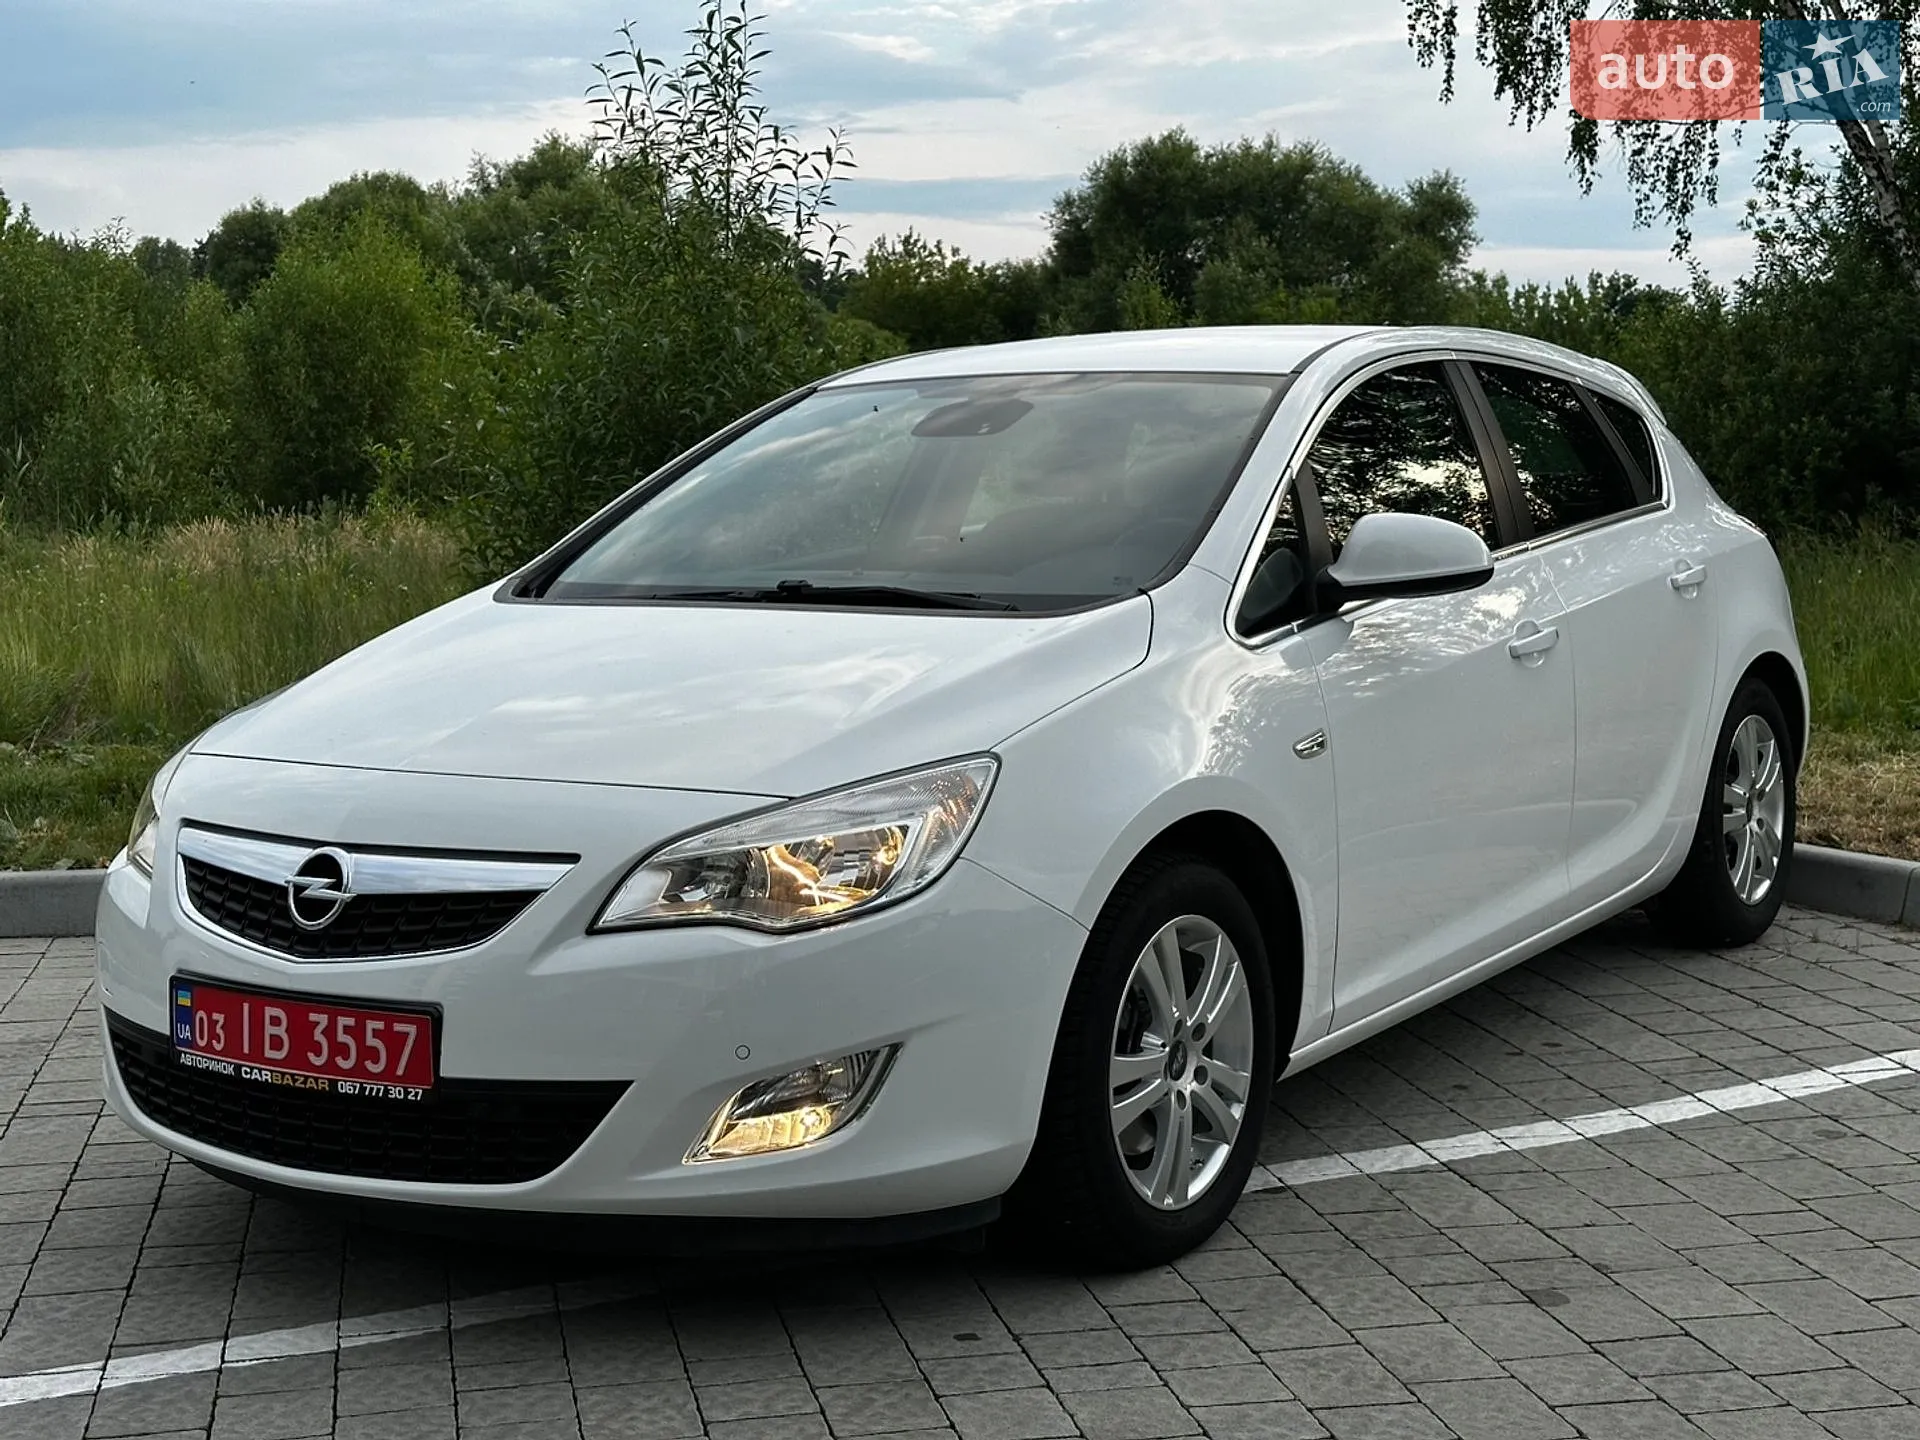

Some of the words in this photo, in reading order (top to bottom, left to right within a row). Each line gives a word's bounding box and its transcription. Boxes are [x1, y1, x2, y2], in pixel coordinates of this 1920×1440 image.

[177, 1022, 192, 1041] UA
[195, 1010, 225, 1051] 03
[306, 1012, 418, 1077] 3557
[180, 1053, 235, 1076] АВТОРИНОК
[241, 1066, 329, 1091] CARBAZAR
[337, 1081, 360, 1095] 067
[363, 1083, 384, 1097] 777
[388, 1086, 404, 1099] 30
[407, 1088, 422, 1101] 27
